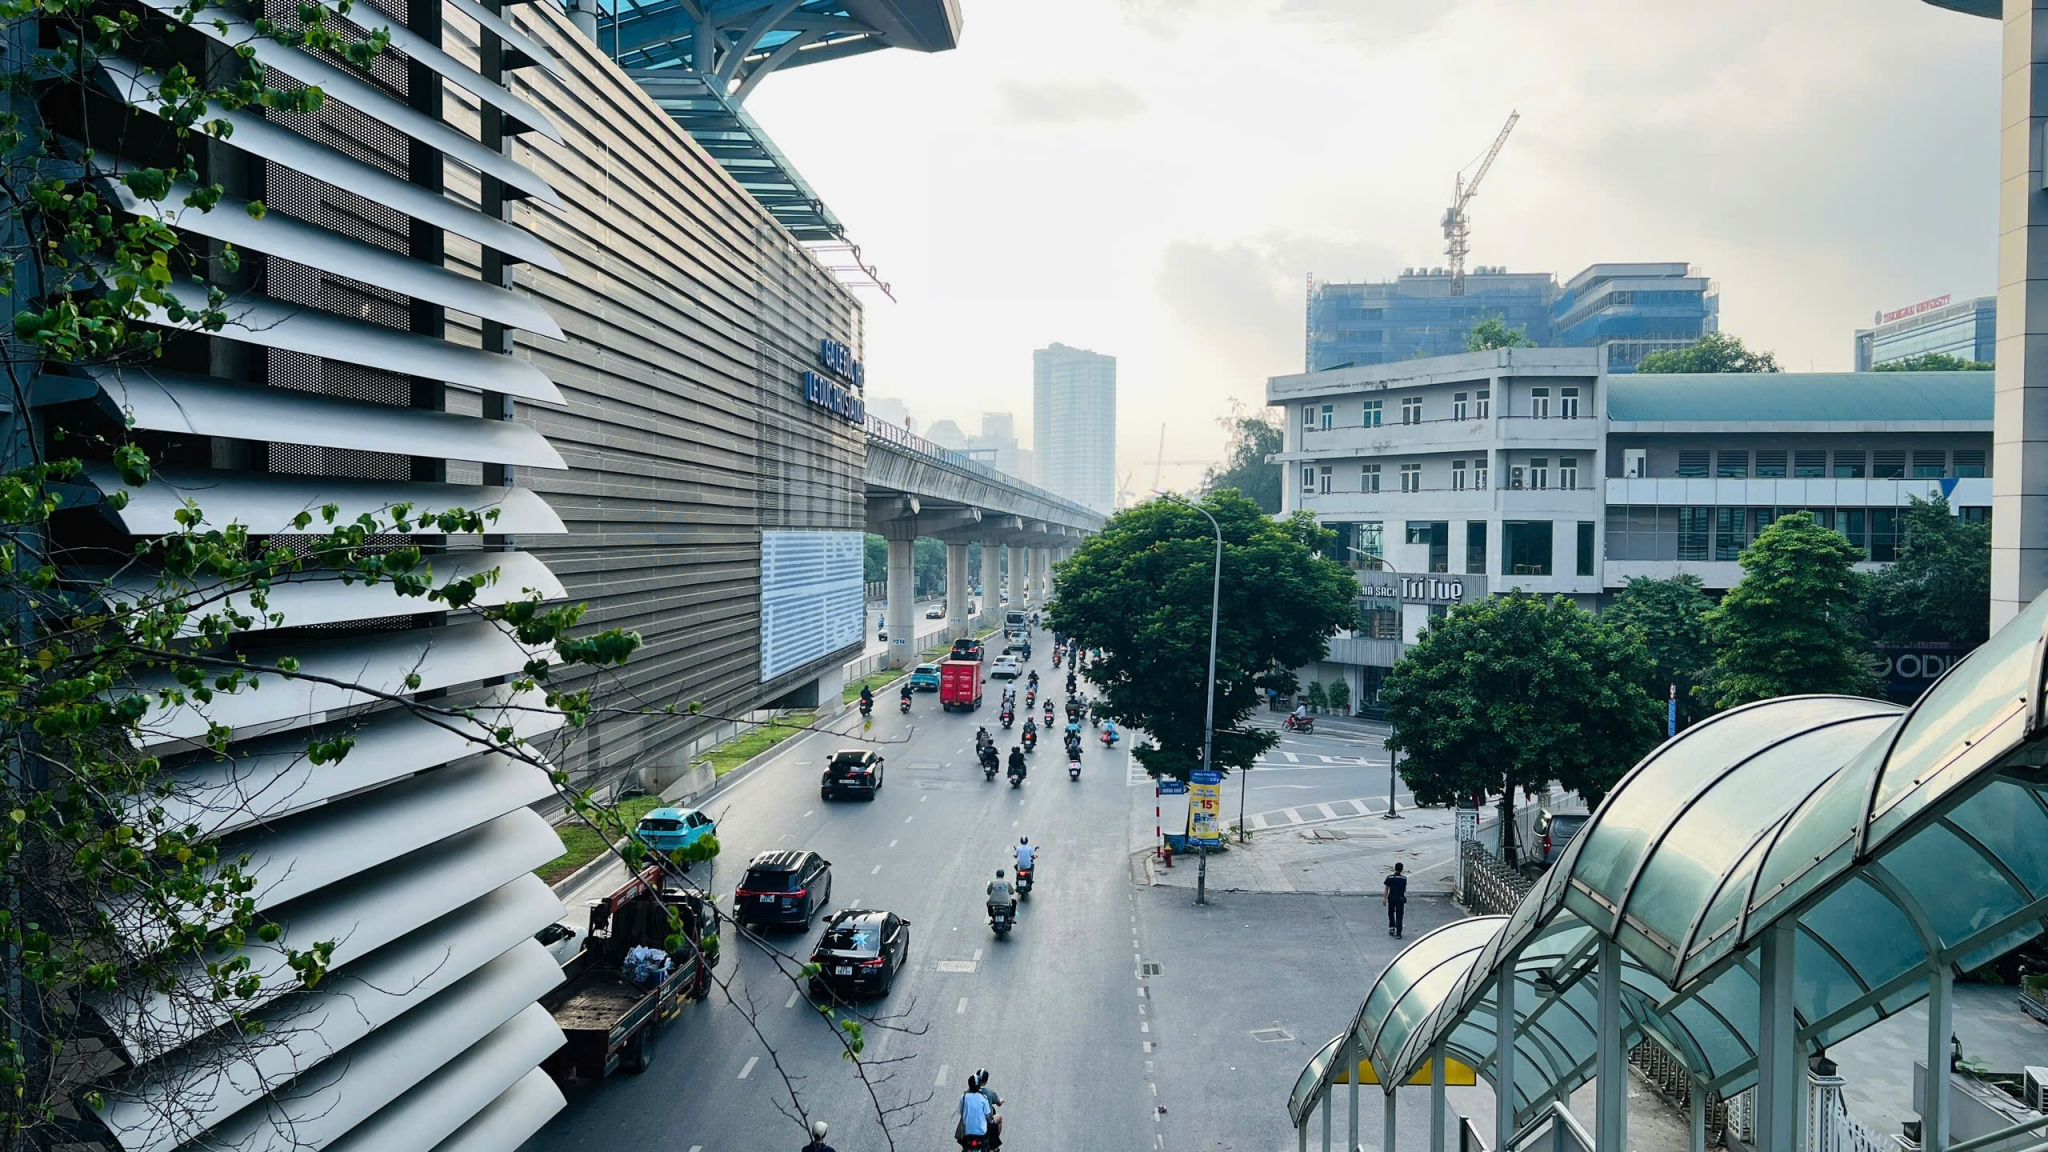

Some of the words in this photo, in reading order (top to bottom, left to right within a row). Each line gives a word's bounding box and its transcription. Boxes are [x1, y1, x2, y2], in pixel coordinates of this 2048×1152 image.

[1916, 294, 1951, 313] UNIVERSITY
[825, 338, 836, 371] GA
[809, 372, 819, 404] LE
[819, 376, 833, 410] DUC
[833, 384, 845, 415] THO
[1358, 583, 1373, 596] HÀ
[1375, 583, 1398, 597] SÁCH
[1400, 577, 1425, 599] Trí
[1428, 578, 1463, 604] Tuệ
